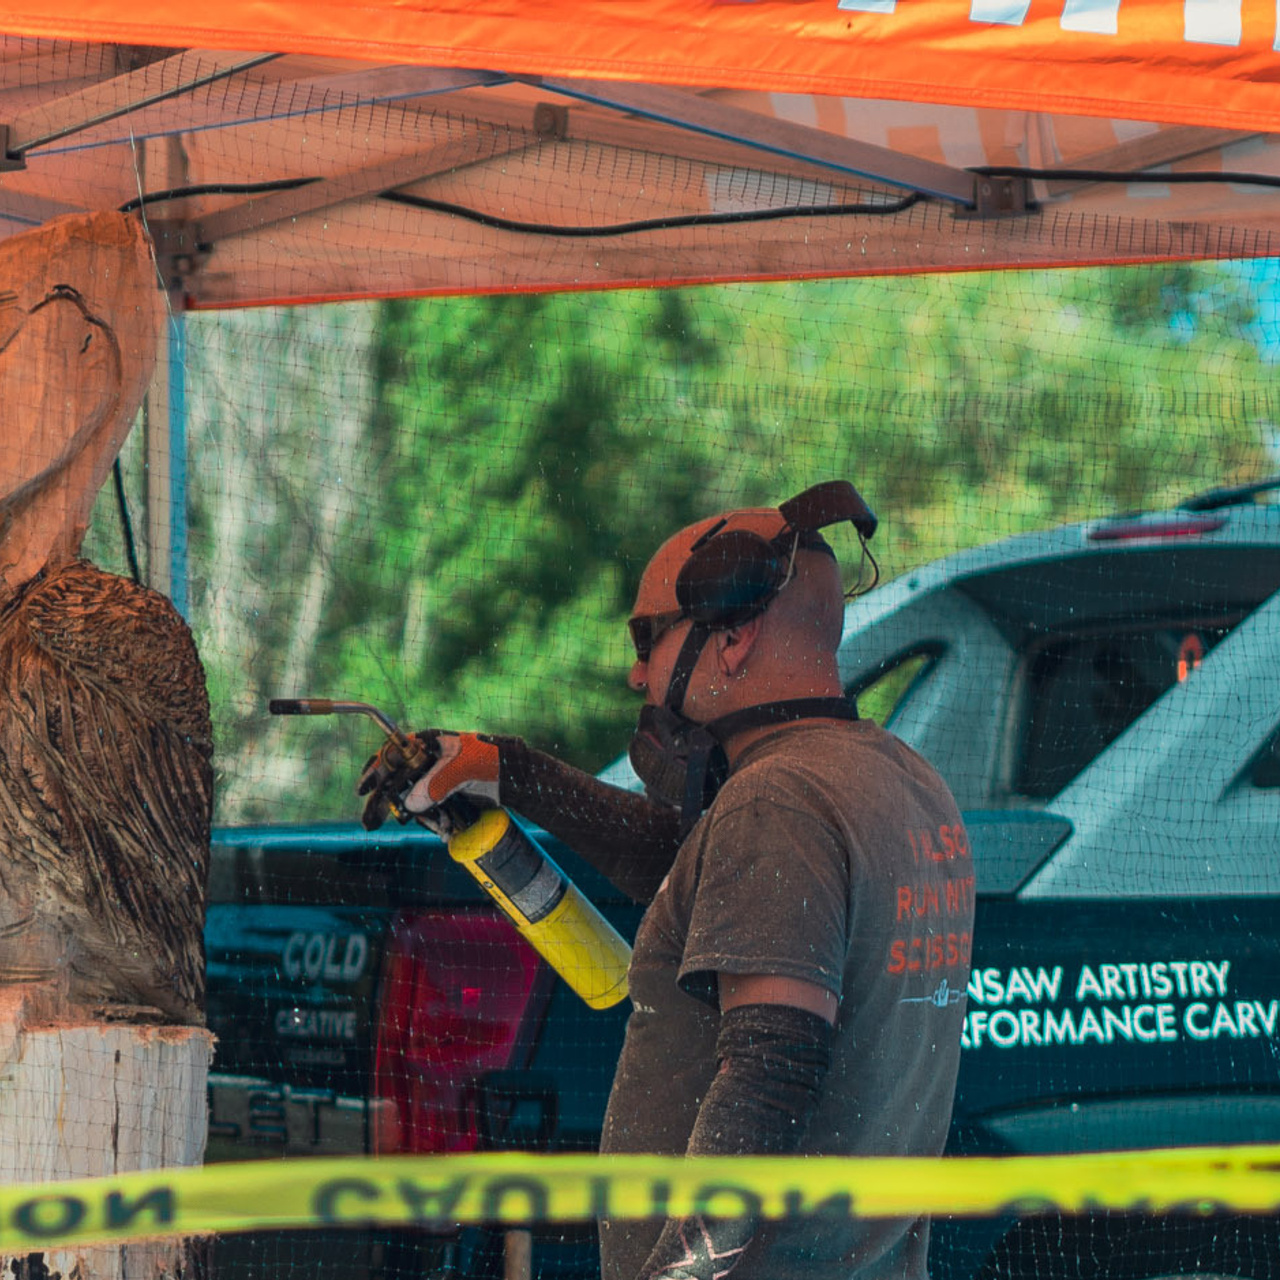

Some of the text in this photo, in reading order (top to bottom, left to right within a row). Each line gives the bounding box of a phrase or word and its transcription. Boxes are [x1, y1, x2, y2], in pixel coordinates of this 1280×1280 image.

[283, 932, 368, 981] COLD
[1075, 959, 1231, 1000] ARTISTRY
[275, 1009, 357, 1039] CREATIVE
[1183, 998, 1278, 1040] CARV
